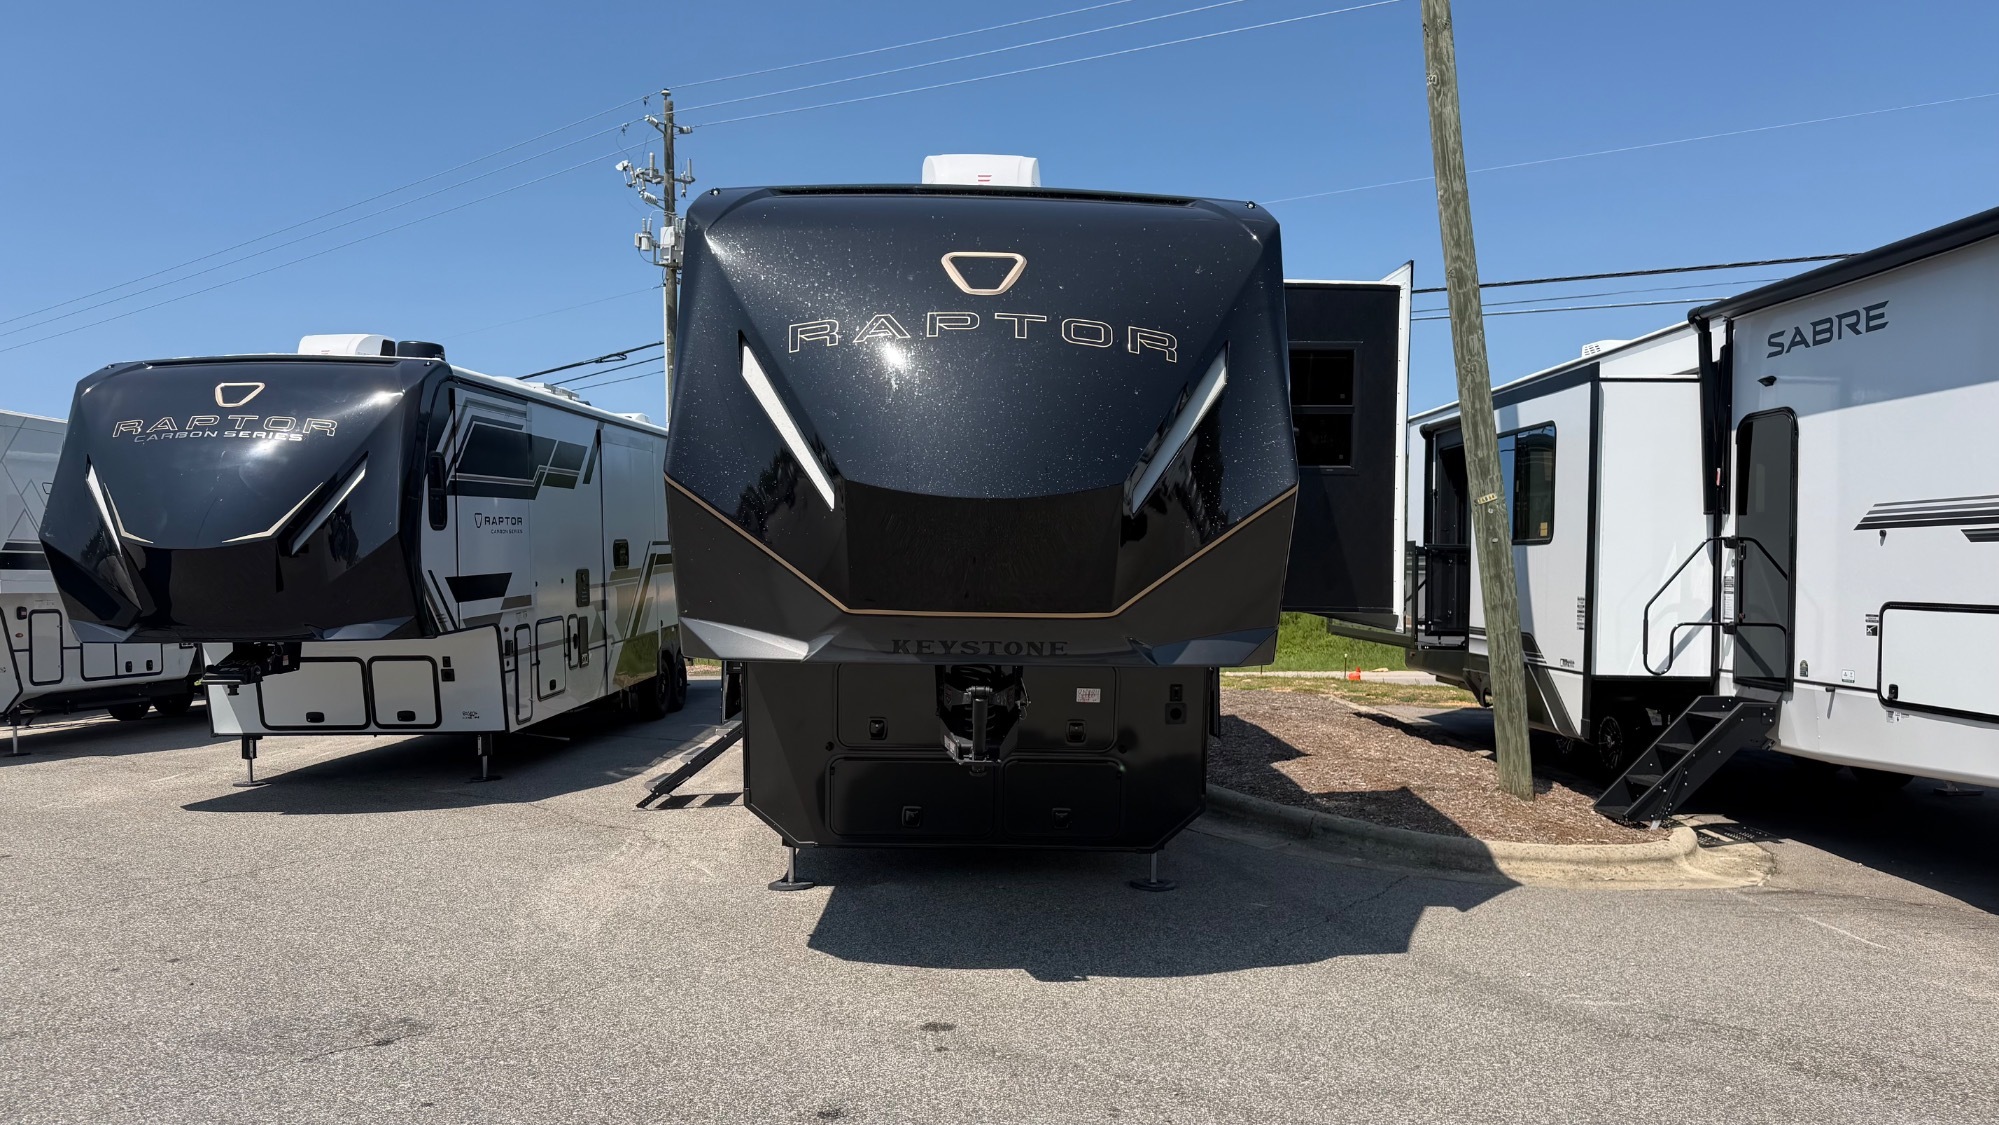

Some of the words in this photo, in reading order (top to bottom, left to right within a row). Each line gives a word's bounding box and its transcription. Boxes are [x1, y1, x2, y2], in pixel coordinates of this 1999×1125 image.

[788, 311, 1178, 363] RAPTOR
[1766, 300, 1889, 359] SABRE
[112, 414, 338, 437] RAPTOR
[134, 430, 218, 443] CARBON
[223, 430, 304, 442] SERIES
[484, 516, 523, 526] RAPTOR
[891, 639, 1068, 656] KEYSTONE
